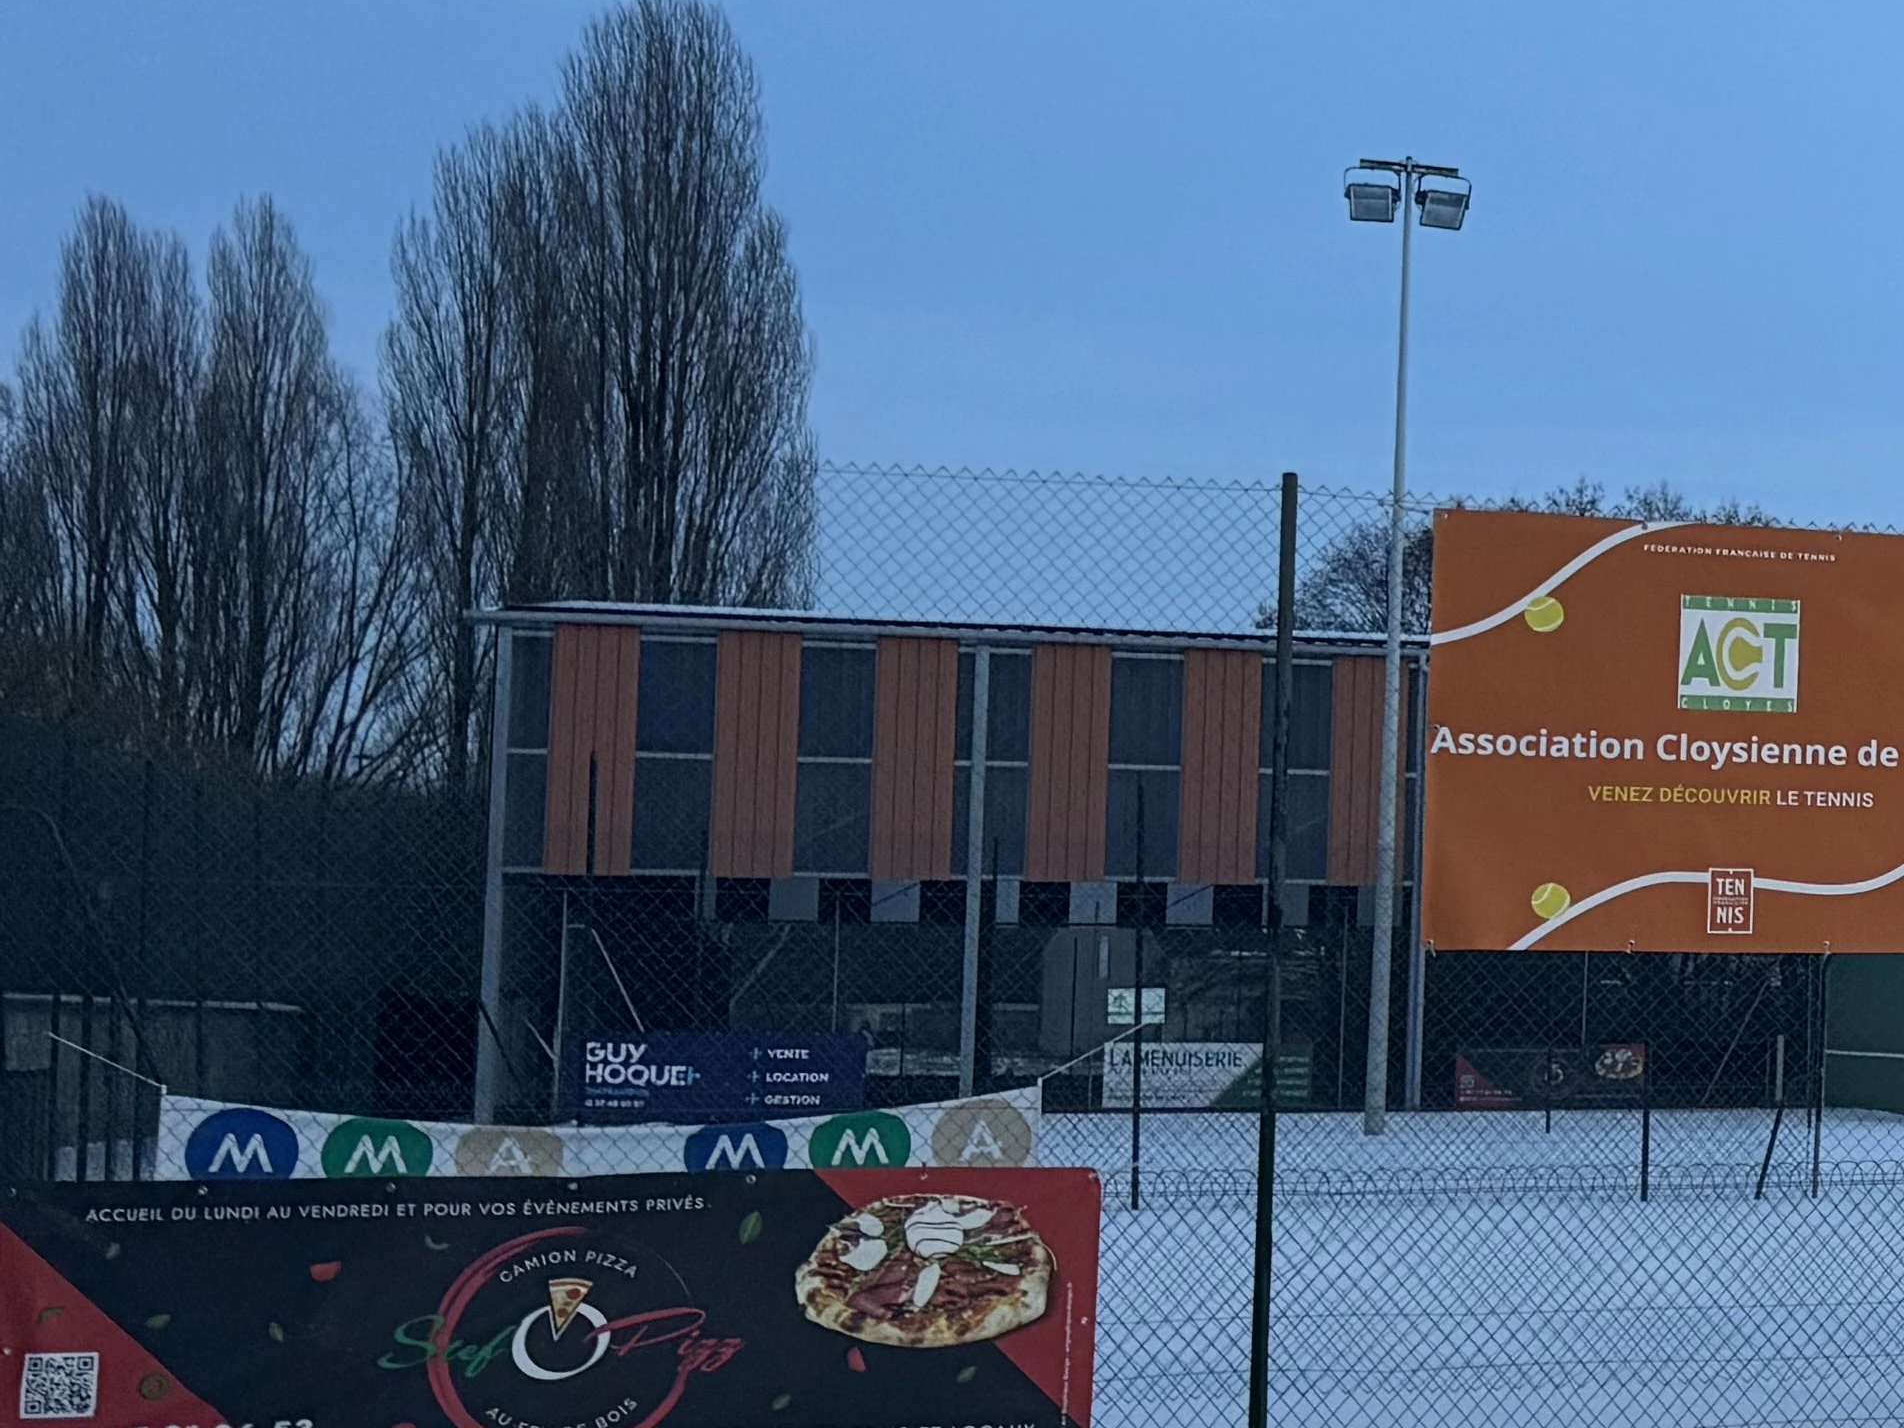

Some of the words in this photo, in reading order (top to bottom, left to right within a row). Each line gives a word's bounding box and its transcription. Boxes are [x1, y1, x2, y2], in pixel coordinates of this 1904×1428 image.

[1780, 552, 1793, 560] DE
[1798, 553, 1836, 562] TENNIS
[1685, 596, 1797, 612] TENNIS
[1680, 617, 1798, 691] ACT
[1681, 697, 1793, 713] CLOYES
[1430, 725, 1643, 760] Association
[1656, 734, 1847, 771] Cloysienne
[1857, 739, 1899, 768] de
[1588, 785, 1654, 803] VENEZ
[1660, 783, 1772, 806] DÉCOUVRIR
[1777, 790, 1800, 807] LE
[1804, 791, 1874, 809] TENNIS
[1716, 878, 1745, 896] TEN
[1716, 907, 1744, 924] NIS
[586, 1041, 648, 1063] GUY
[767, 1049, 810, 1060] VENTE
[1109, 1049, 1132, 1067] LA
[766, 1072, 829, 1083] LOCATION
[764, 1094, 820, 1105] GESTION
[85, 1208, 164, 1222] ACCUEIL
[171, 1207, 196, 1221] DU
[204, 1206, 260, 1221] LUNDI
[266, 1206, 292, 1219] AU
[298, 1204, 388, 1219] VENDREDI
[396, 1204, 416, 1217] ET
[423, 1203, 471, 1217] POUR
[478, 1202, 516, 1216] VOS
[500, 1249, 577, 1283] CAMION
[585, 1250, 638, 1279] PIZZA
[485, 1407, 512, 1427] AU
